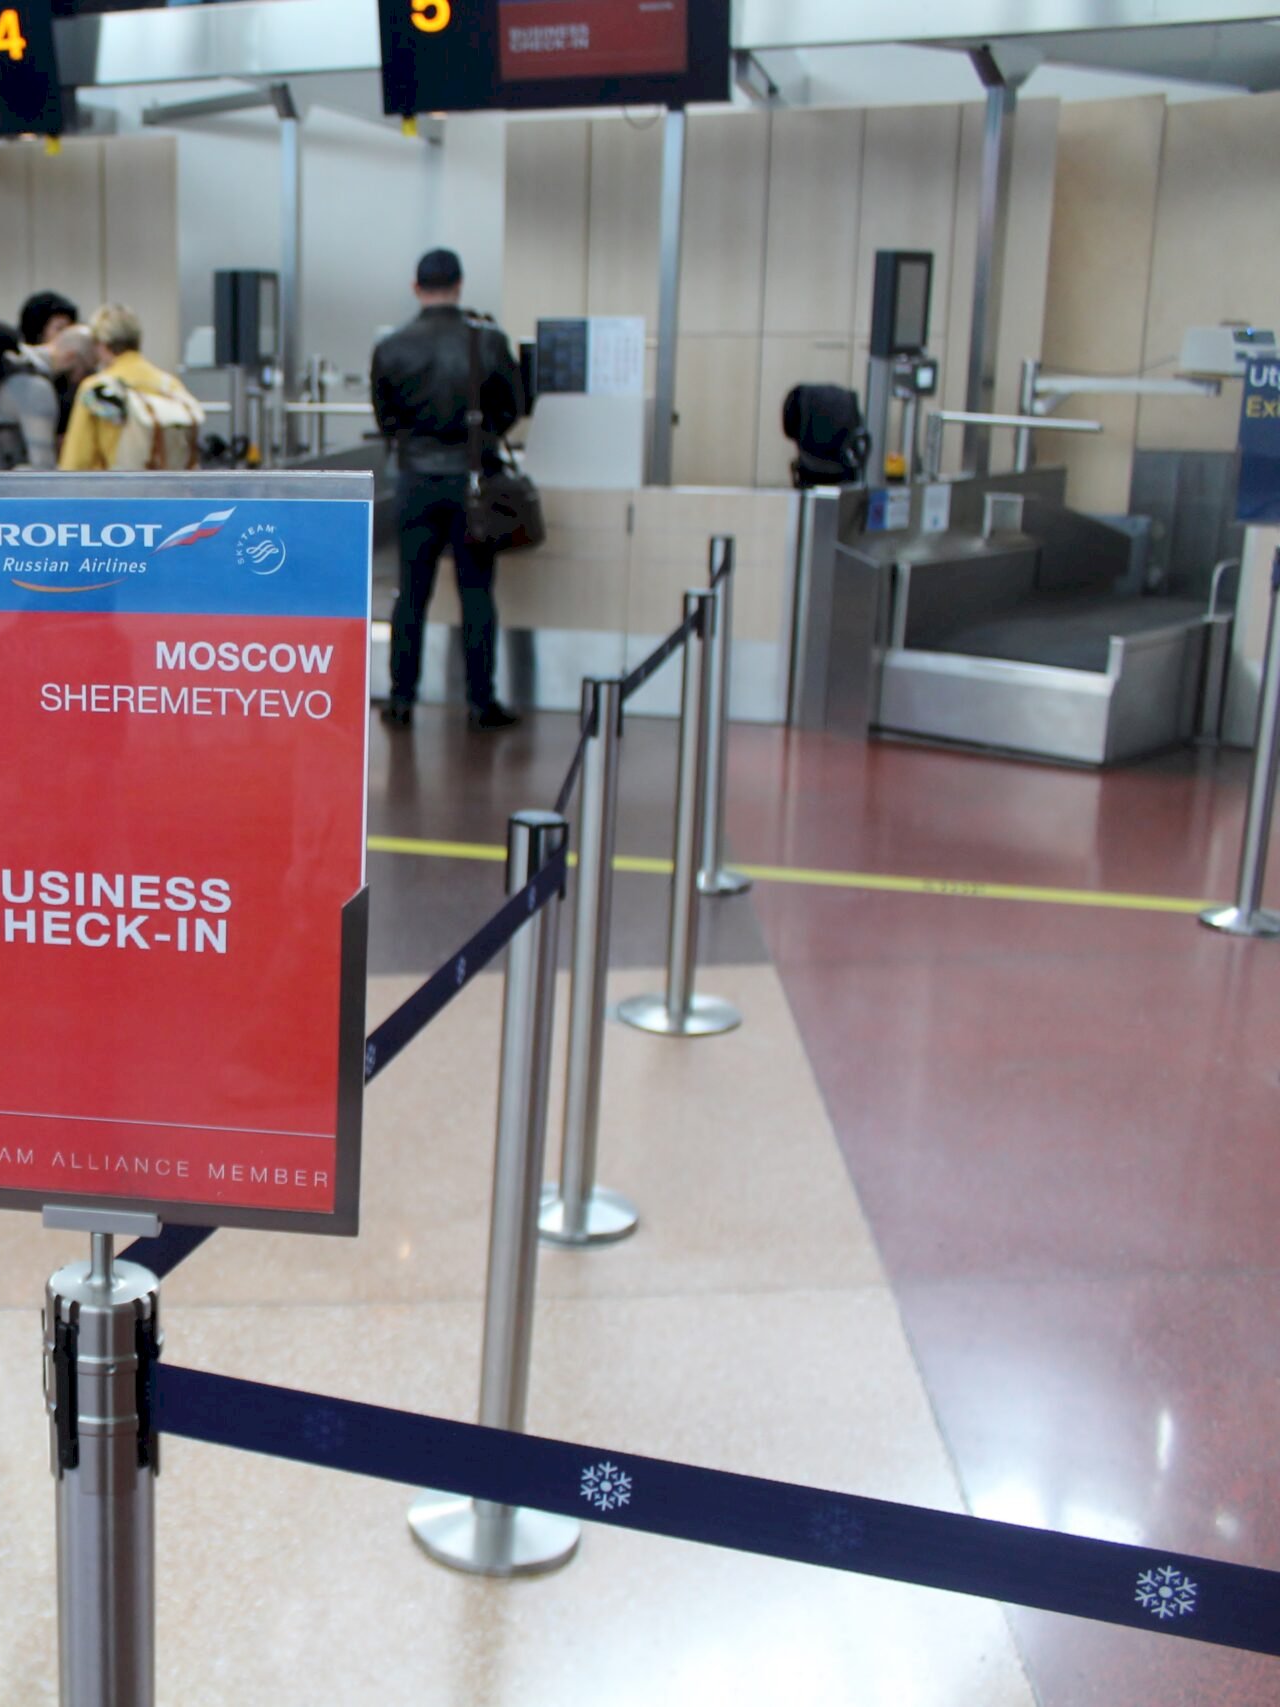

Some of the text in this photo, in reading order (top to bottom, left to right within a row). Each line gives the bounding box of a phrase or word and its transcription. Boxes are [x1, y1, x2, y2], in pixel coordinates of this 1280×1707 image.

[410, 0, 452, 33] 5
[1249, 364, 1280, 392] Ut
[236, 523, 276, 566] SKYTEAM
[3, 556, 148, 574] Russian Airlines
[155, 641, 334, 675] MOSCOW
[39, 682, 333, 720] SHEREMETYEVO
[51, 1150, 190, 1178] ALLIANCE
[208, 1162, 329, 1188] MEMBER
